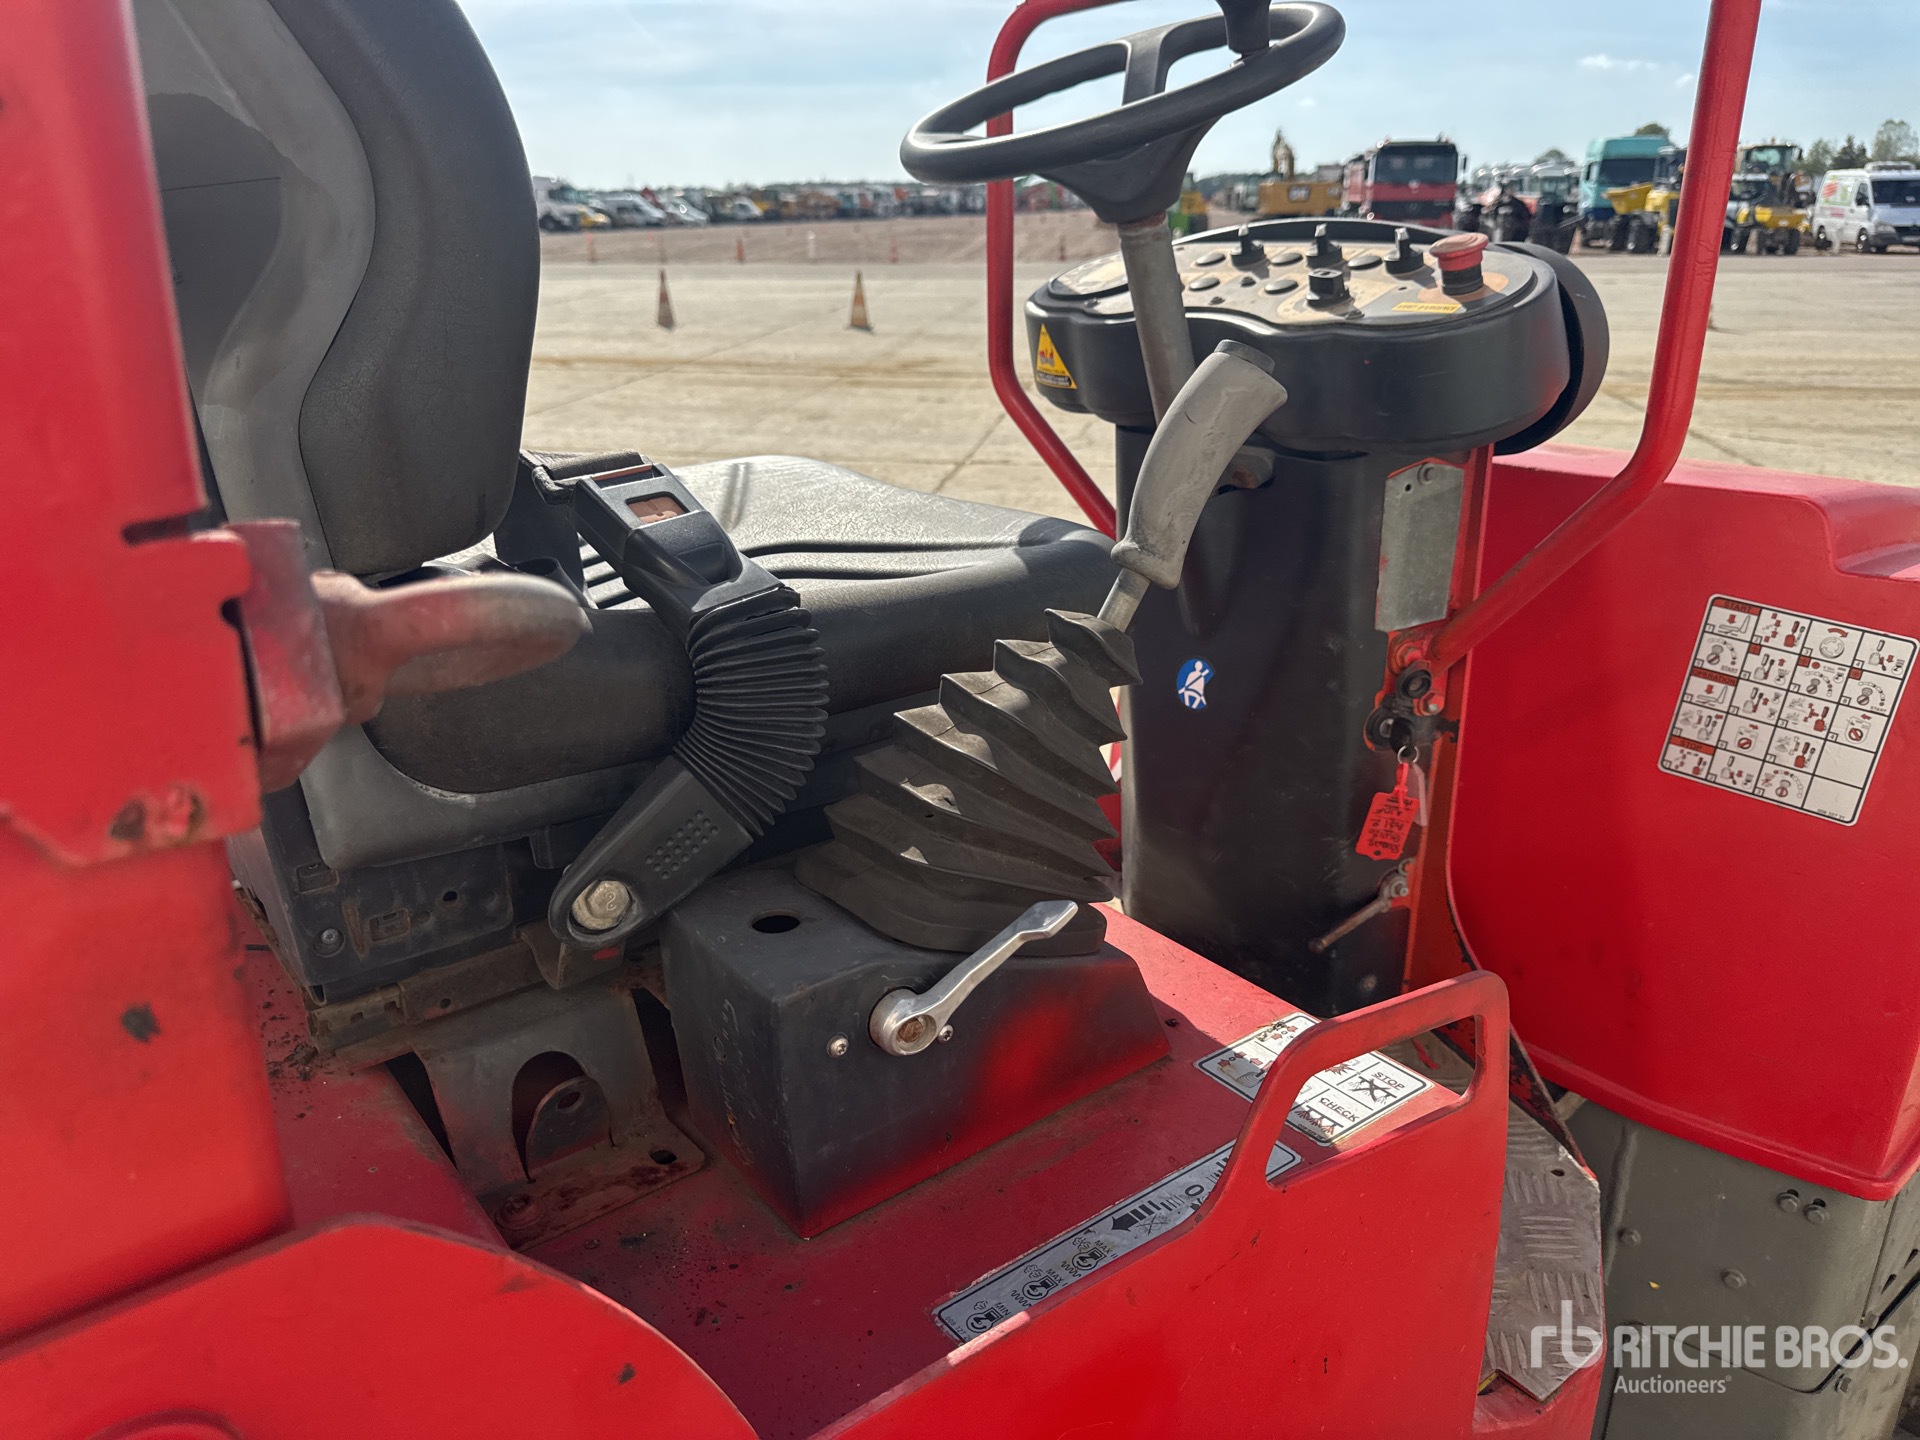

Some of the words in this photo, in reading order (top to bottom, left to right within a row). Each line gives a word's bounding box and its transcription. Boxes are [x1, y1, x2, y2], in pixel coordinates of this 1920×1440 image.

[1724, 600, 1751, 613] START
[1680, 739, 1702, 750] STOP
[1373, 1072, 1405, 1090] STOP
[1319, 1097, 1360, 1122] CHECK
[1094, 1239, 1111, 1254] MAX
[1046, 1268, 1064, 1283] MAX
[994, 1302, 1011, 1316] MIN
